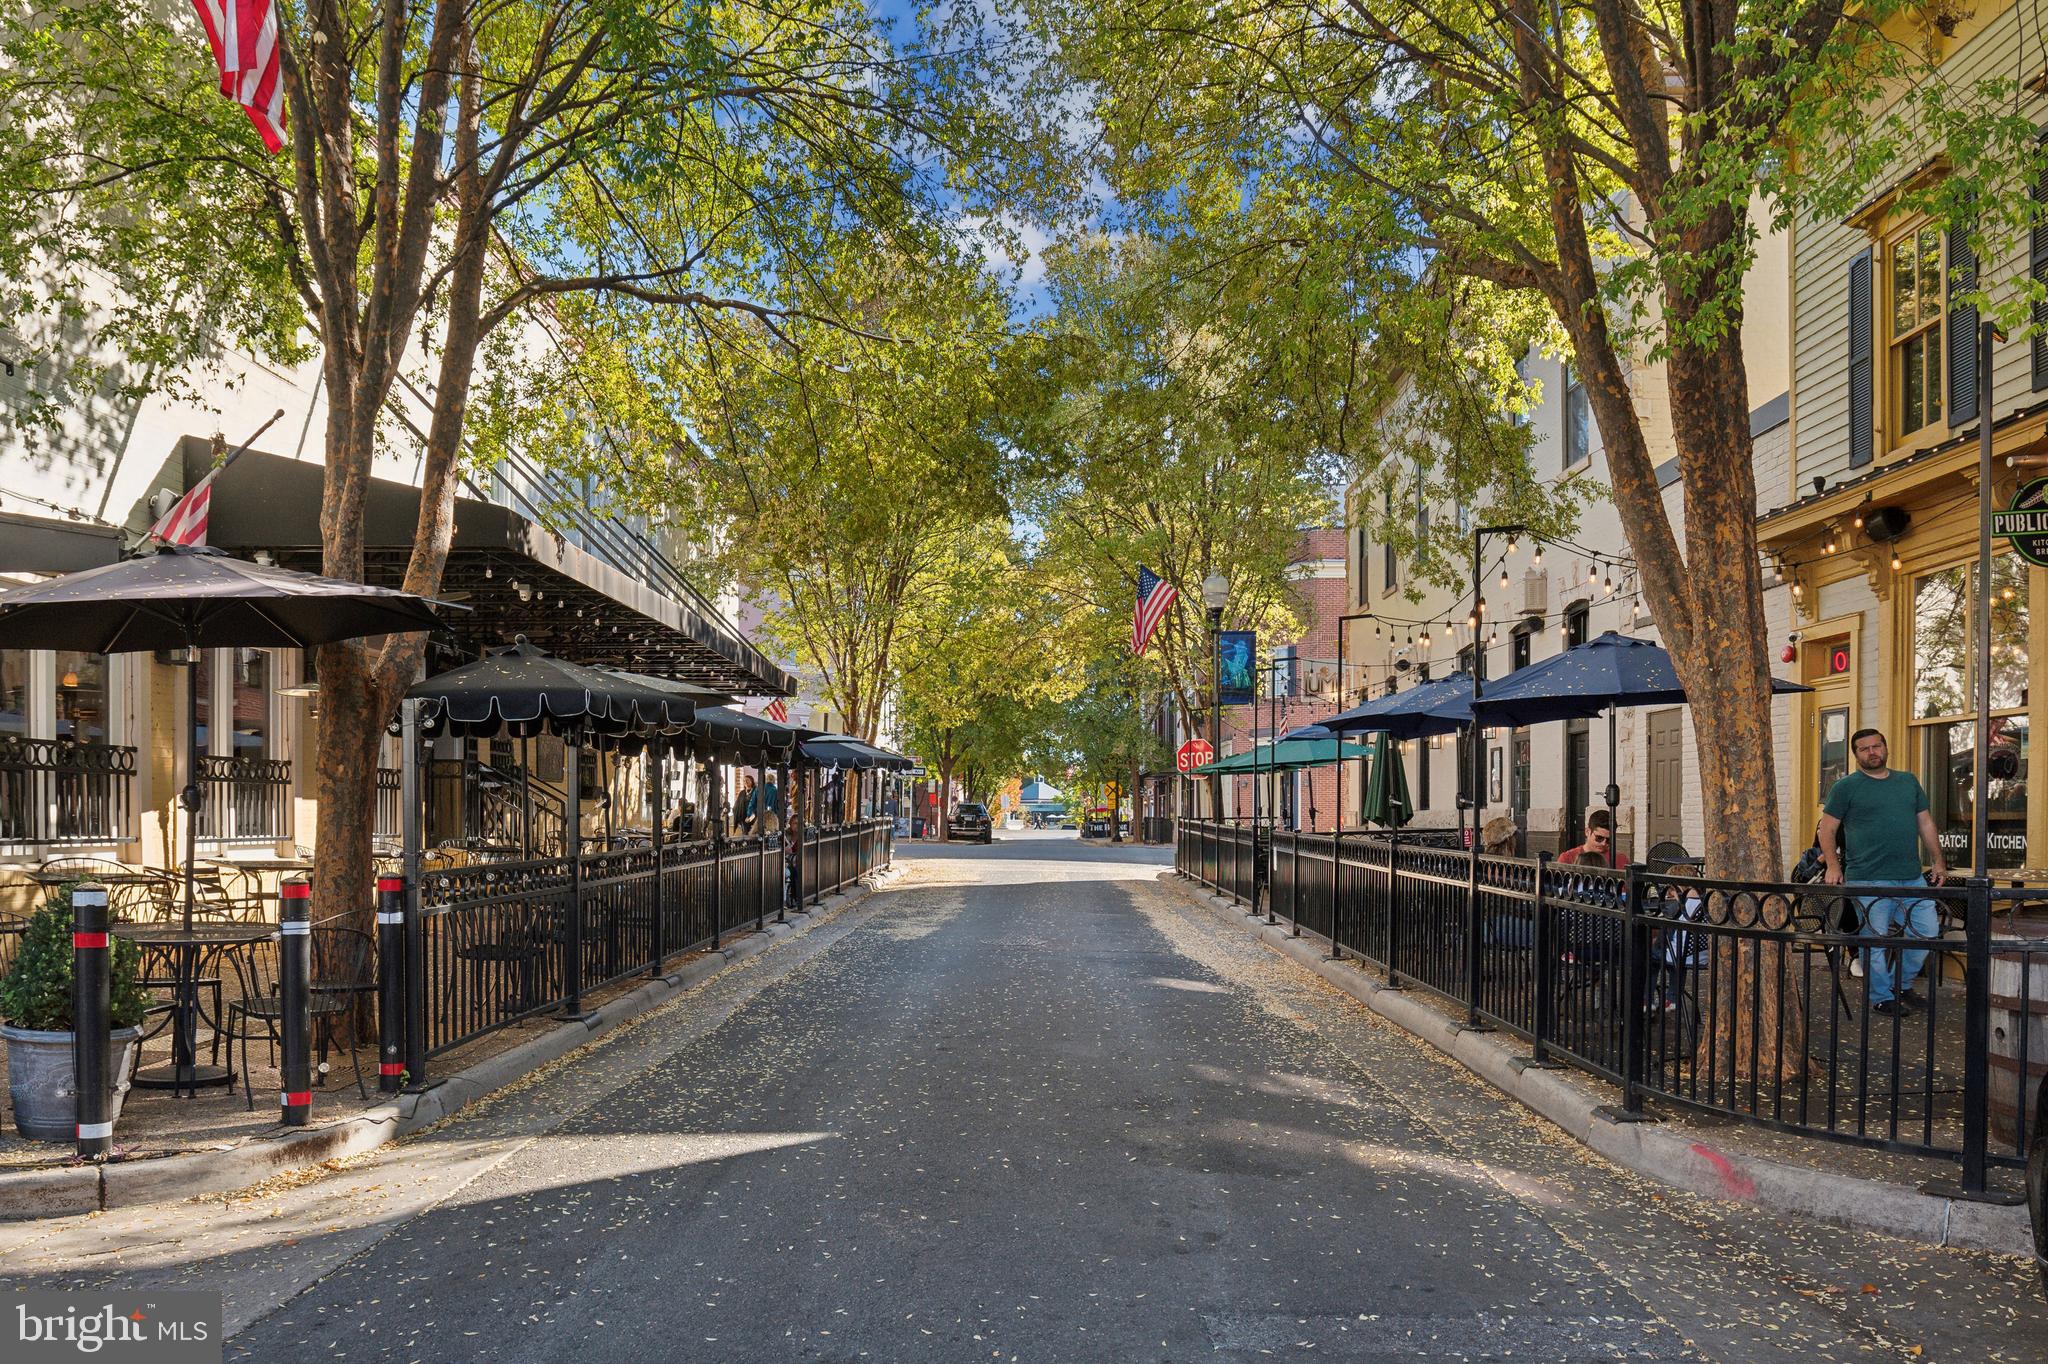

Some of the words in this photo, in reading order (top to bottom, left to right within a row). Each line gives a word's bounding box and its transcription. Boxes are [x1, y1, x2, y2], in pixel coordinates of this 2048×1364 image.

[1994, 513, 2048, 533] PUBLIC
[1180, 751, 1214, 767] STOP
[1987, 832, 2028, 849] KITCHEN
